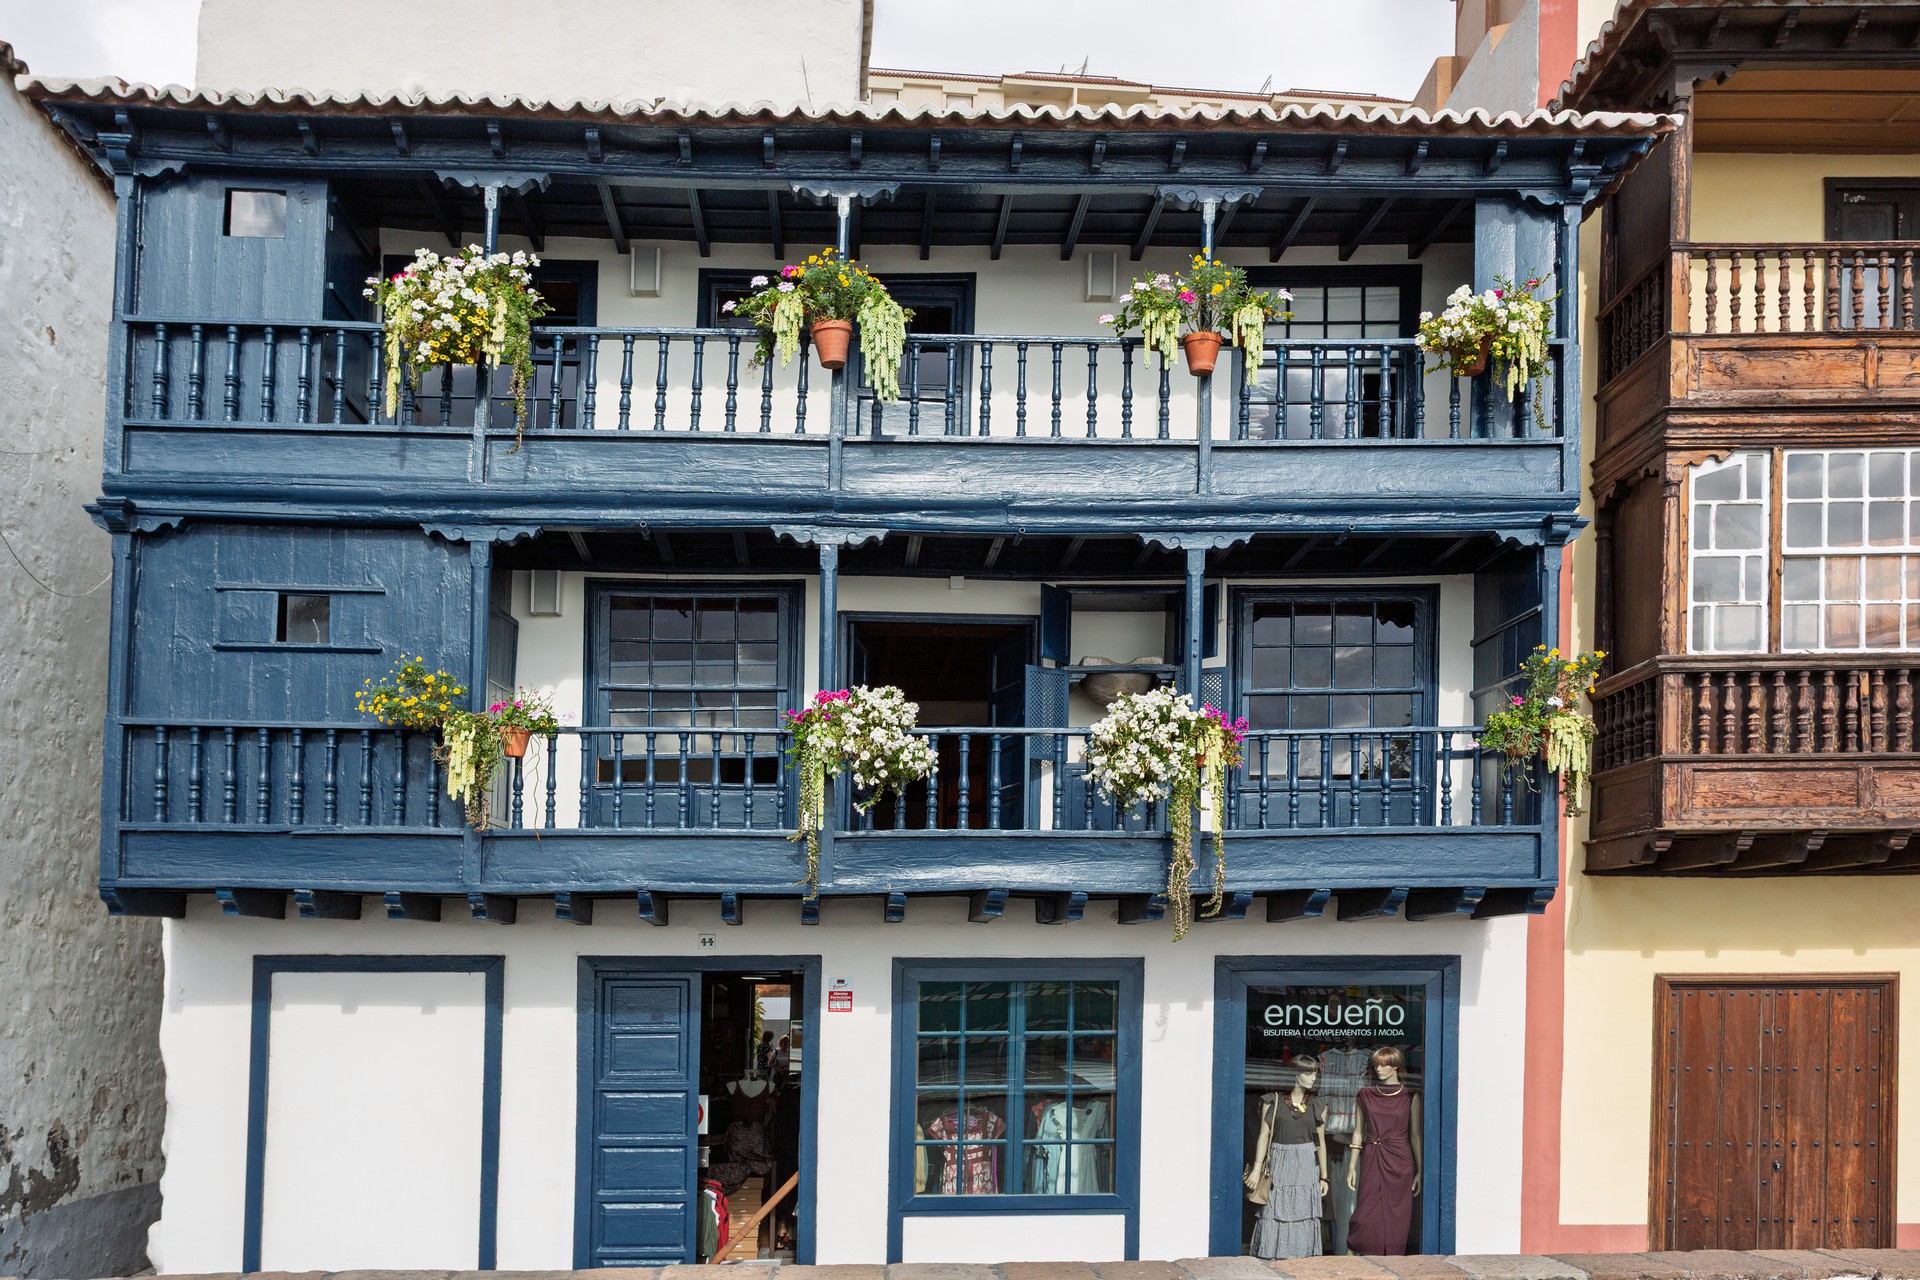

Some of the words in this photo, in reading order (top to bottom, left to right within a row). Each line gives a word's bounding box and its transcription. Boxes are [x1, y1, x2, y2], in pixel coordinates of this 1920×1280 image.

[700, 937, 714, 946] 44
[1264, 998, 1405, 1026] ensueño
[1263, 1029, 1301, 1037] BISUTERIA
[1307, 1029, 1372, 1037] COMPLEMENTOS
[1378, 1029, 1404, 1037] MODA
